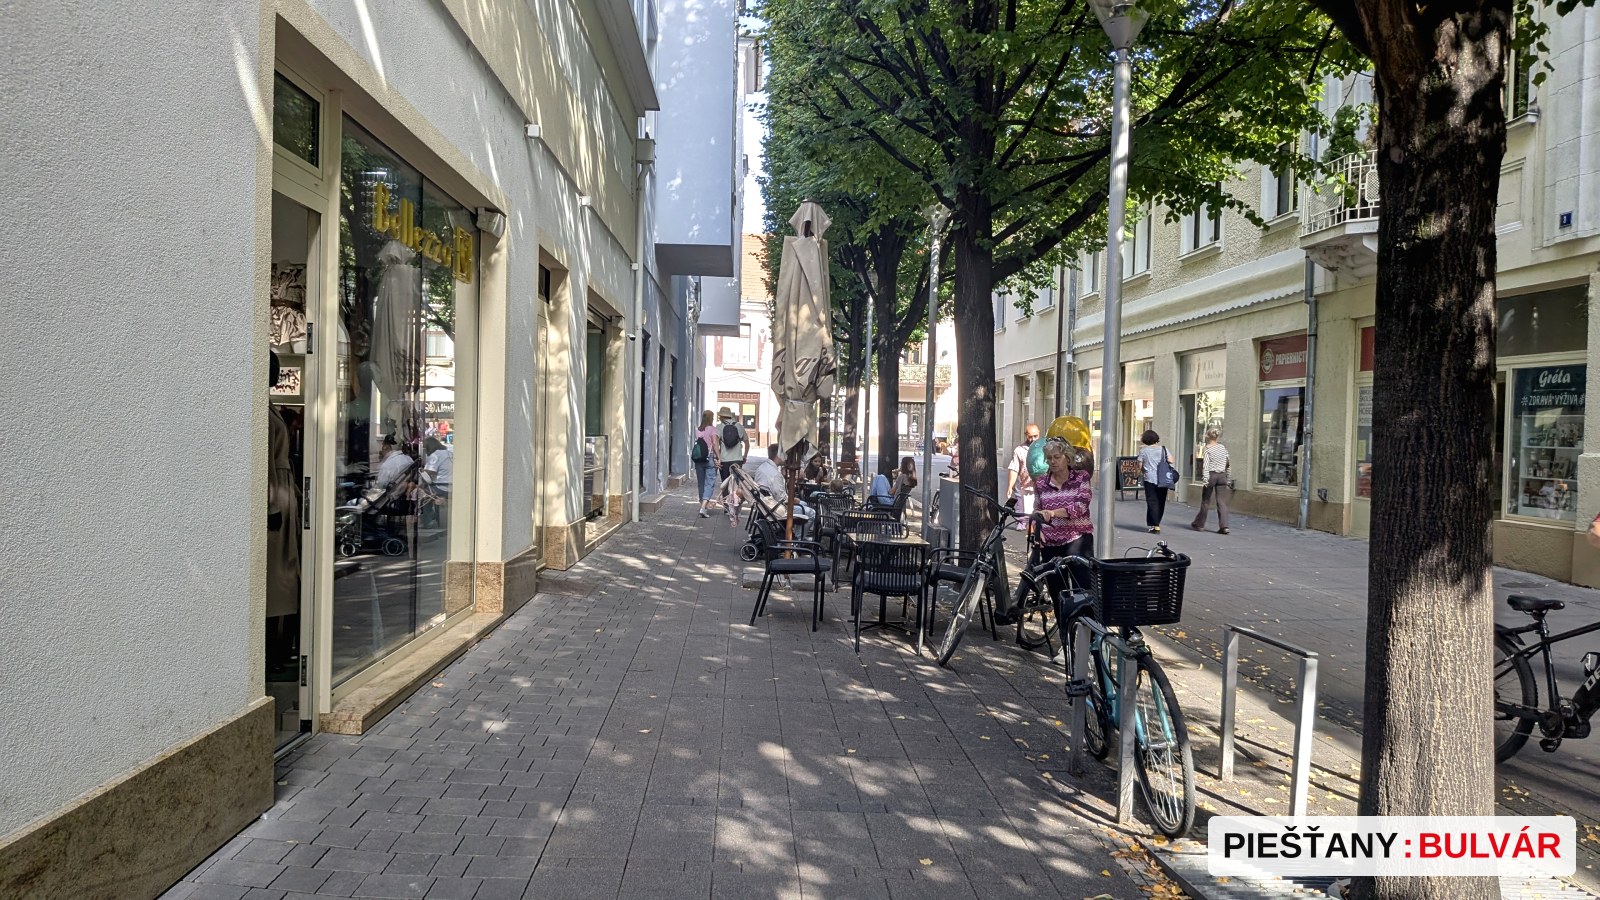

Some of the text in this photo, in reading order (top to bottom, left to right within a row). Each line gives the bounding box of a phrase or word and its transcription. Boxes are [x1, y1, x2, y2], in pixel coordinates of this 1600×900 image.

[1275, 350, 1308, 366] PAPIERNICT
[1538, 368, 1571, 388] Gréta
[1528, 391, 1578, 406] ZDRAVÁ VÝŽIVA
